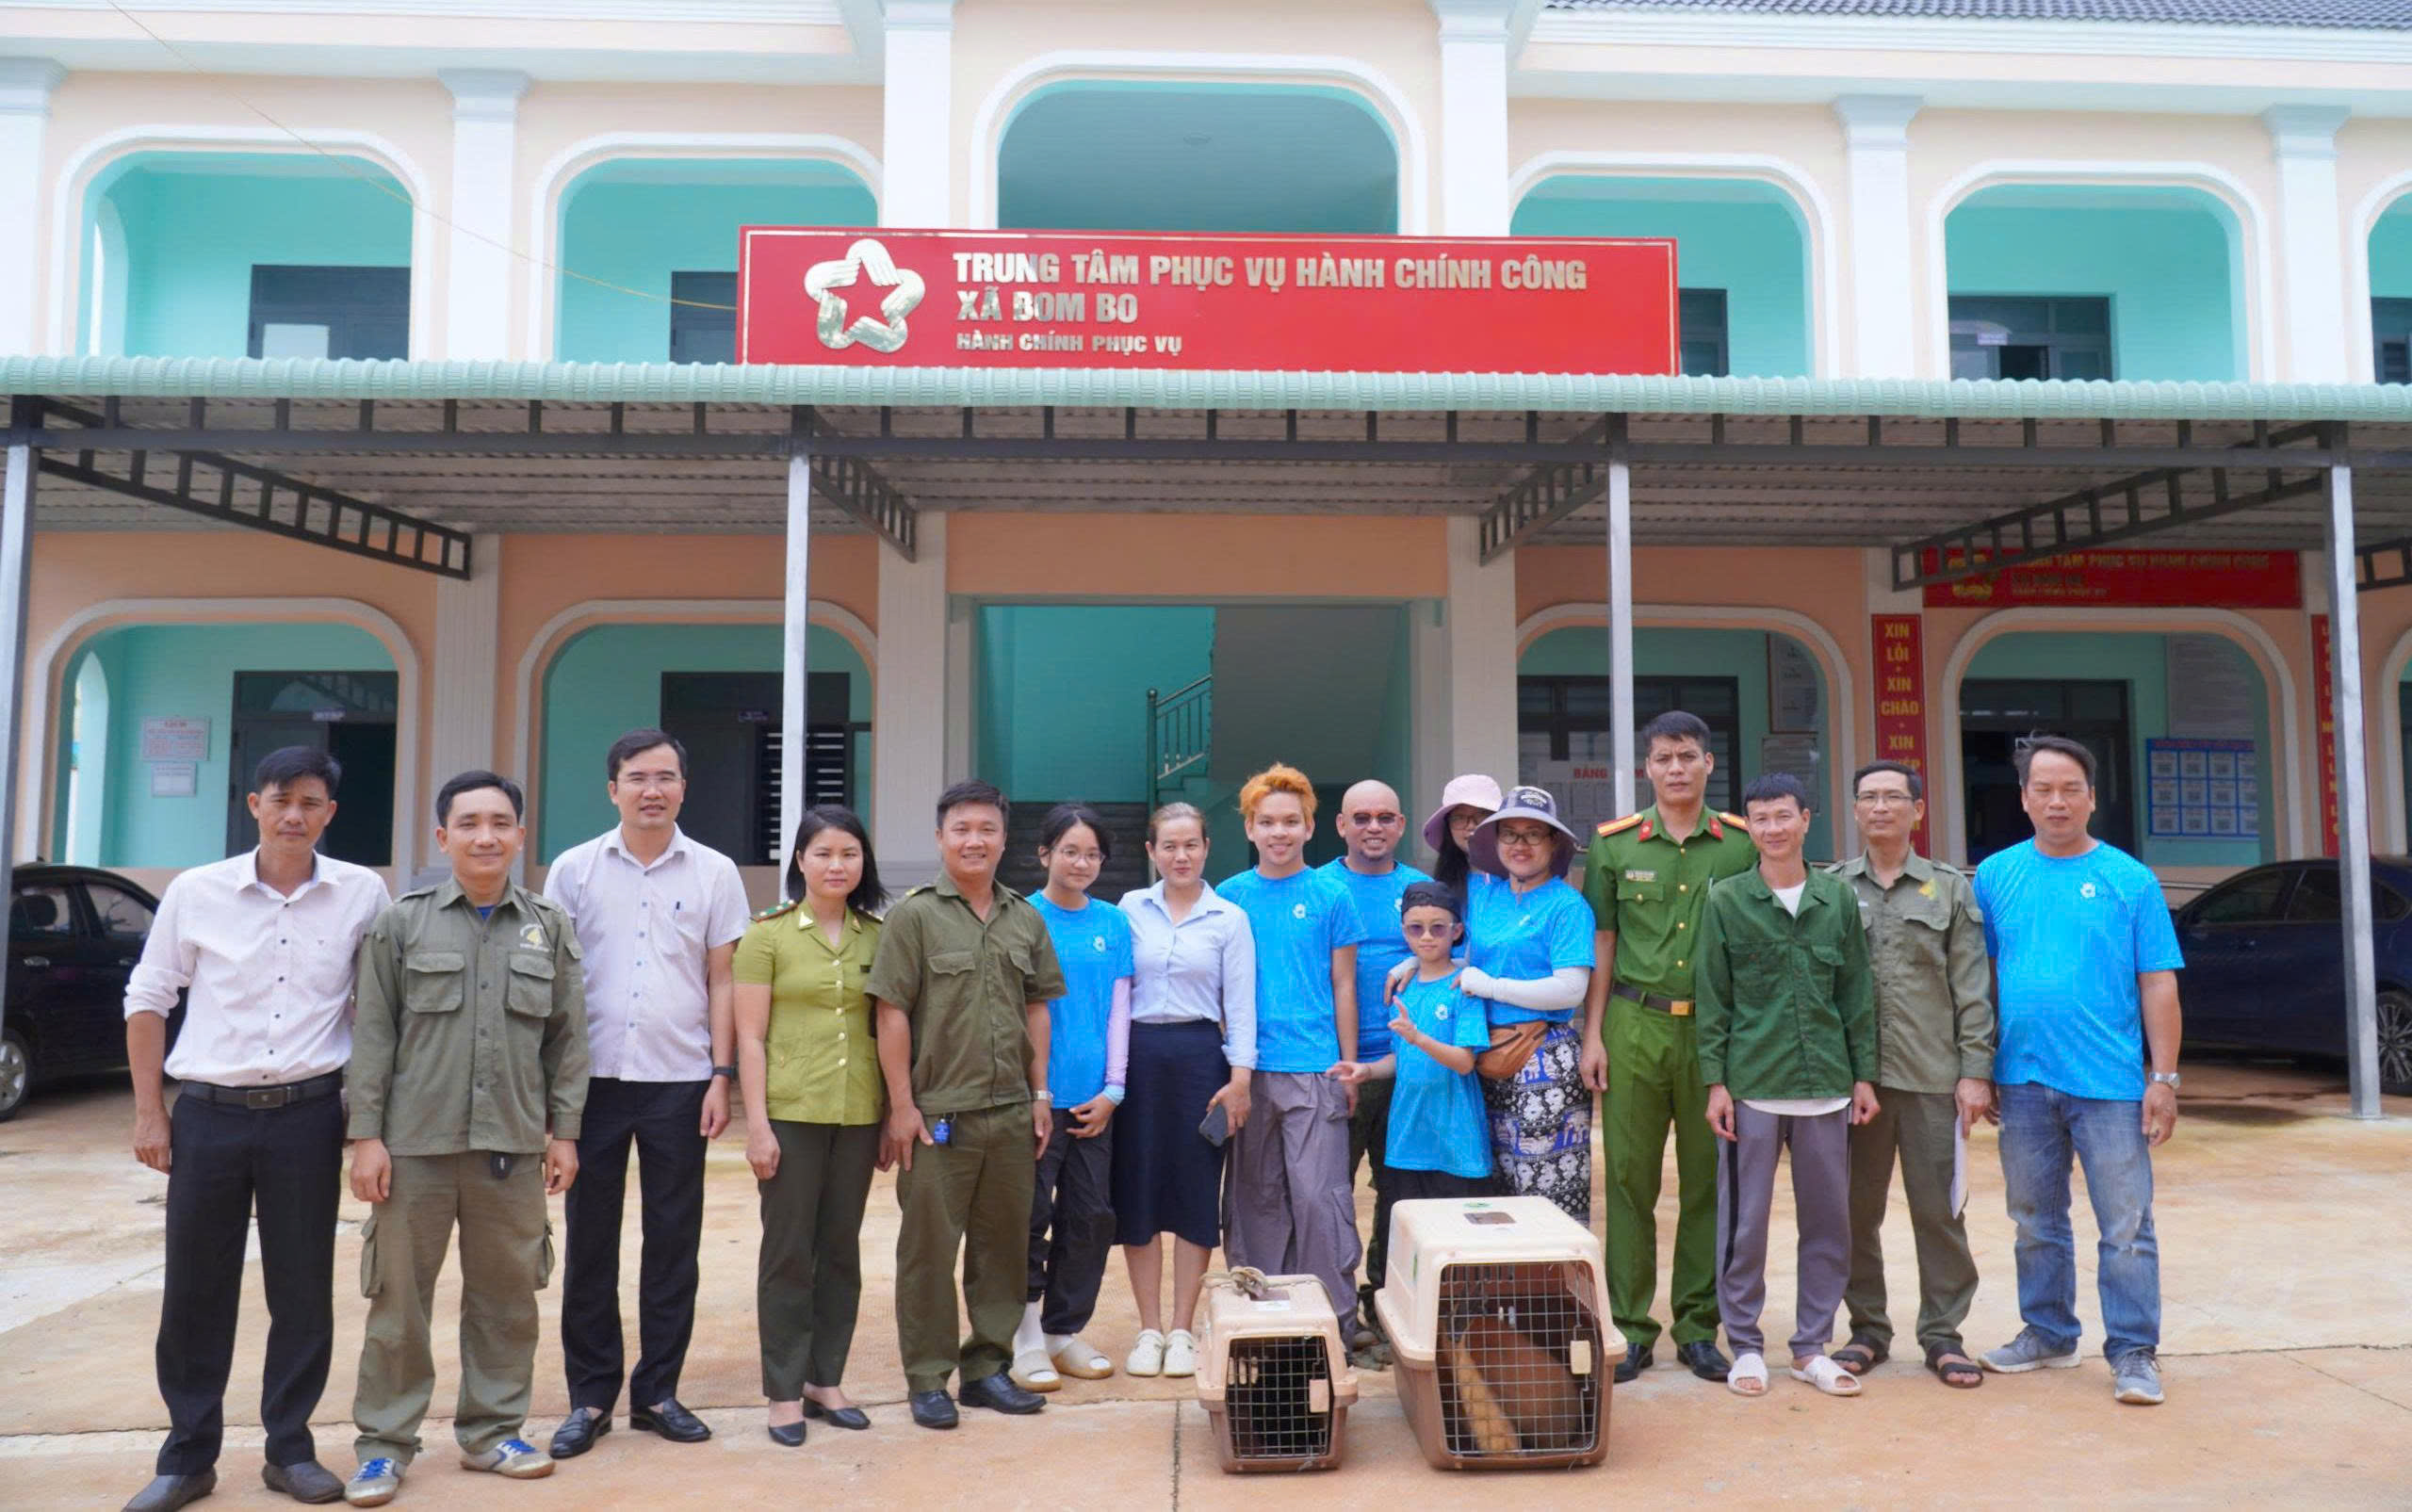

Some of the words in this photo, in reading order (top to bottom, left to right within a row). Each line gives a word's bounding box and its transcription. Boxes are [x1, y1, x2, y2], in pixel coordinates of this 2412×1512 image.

[953, 252, 1060, 284] TRUNG
[1070, 248, 1139, 285] TÂM
[1149, 254, 1234, 291] PHỤC
[1244, 257, 1286, 293] VỤ
[1296, 252, 1385, 288] HÀNH
[1394, 252, 1491, 289] CHÍNH
[1501, 253, 1588, 290] CÔNG
[956, 285, 1002, 321] XÃ
[1012, 290, 1086, 322] BOM
[1096, 292, 1138, 323] BO
[956, 329, 1014, 350] HÀNH
[1019, 330, 1084, 351] CHÍNH
[1092, 334, 1148, 357] PHỤC
[1153, 335, 1182, 357] VỤ
[1885, 623, 1910, 638] XIN
[1887, 677, 1912, 692] XIN
[1889, 735, 1915, 750] XIN
